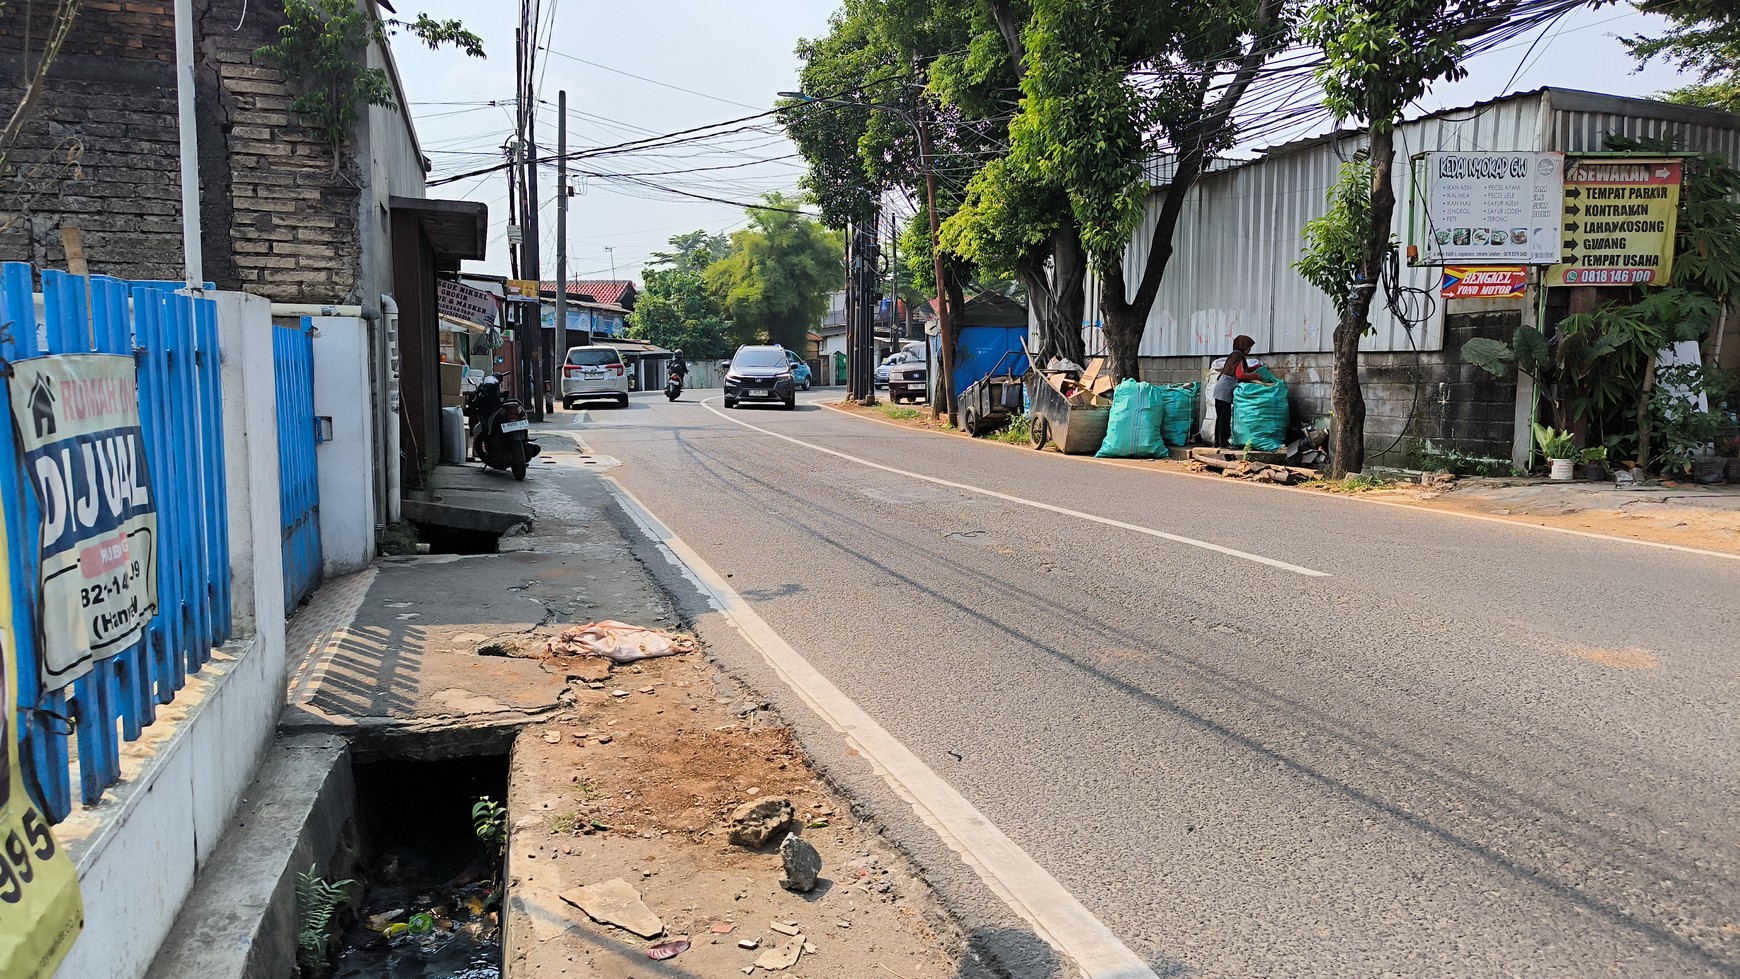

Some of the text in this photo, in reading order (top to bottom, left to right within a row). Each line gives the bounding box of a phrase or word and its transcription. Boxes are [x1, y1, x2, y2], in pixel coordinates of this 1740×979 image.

[1439, 155, 1528, 179] KEDAI NYOKAP GW
[1585, 186, 1668, 200] TEMPAT PARKIR
[1618, 220, 1665, 233] KOSONG
[1581, 254, 1659, 267] TEMPAT USAHA
[1461, 271, 1513, 285] BENGKEL
[1581, 270, 1652, 283] 0818 146 100
[441, 289, 468, 301] GROSIR
[459, 286, 488, 300] NIKSEL
[1456, 285, 1512, 295] YONO MOTOR
[456, 300, 487, 314] MASKER
[60, 376, 117, 422] RUMAH
[36, 434, 149, 549] DIJUAL
